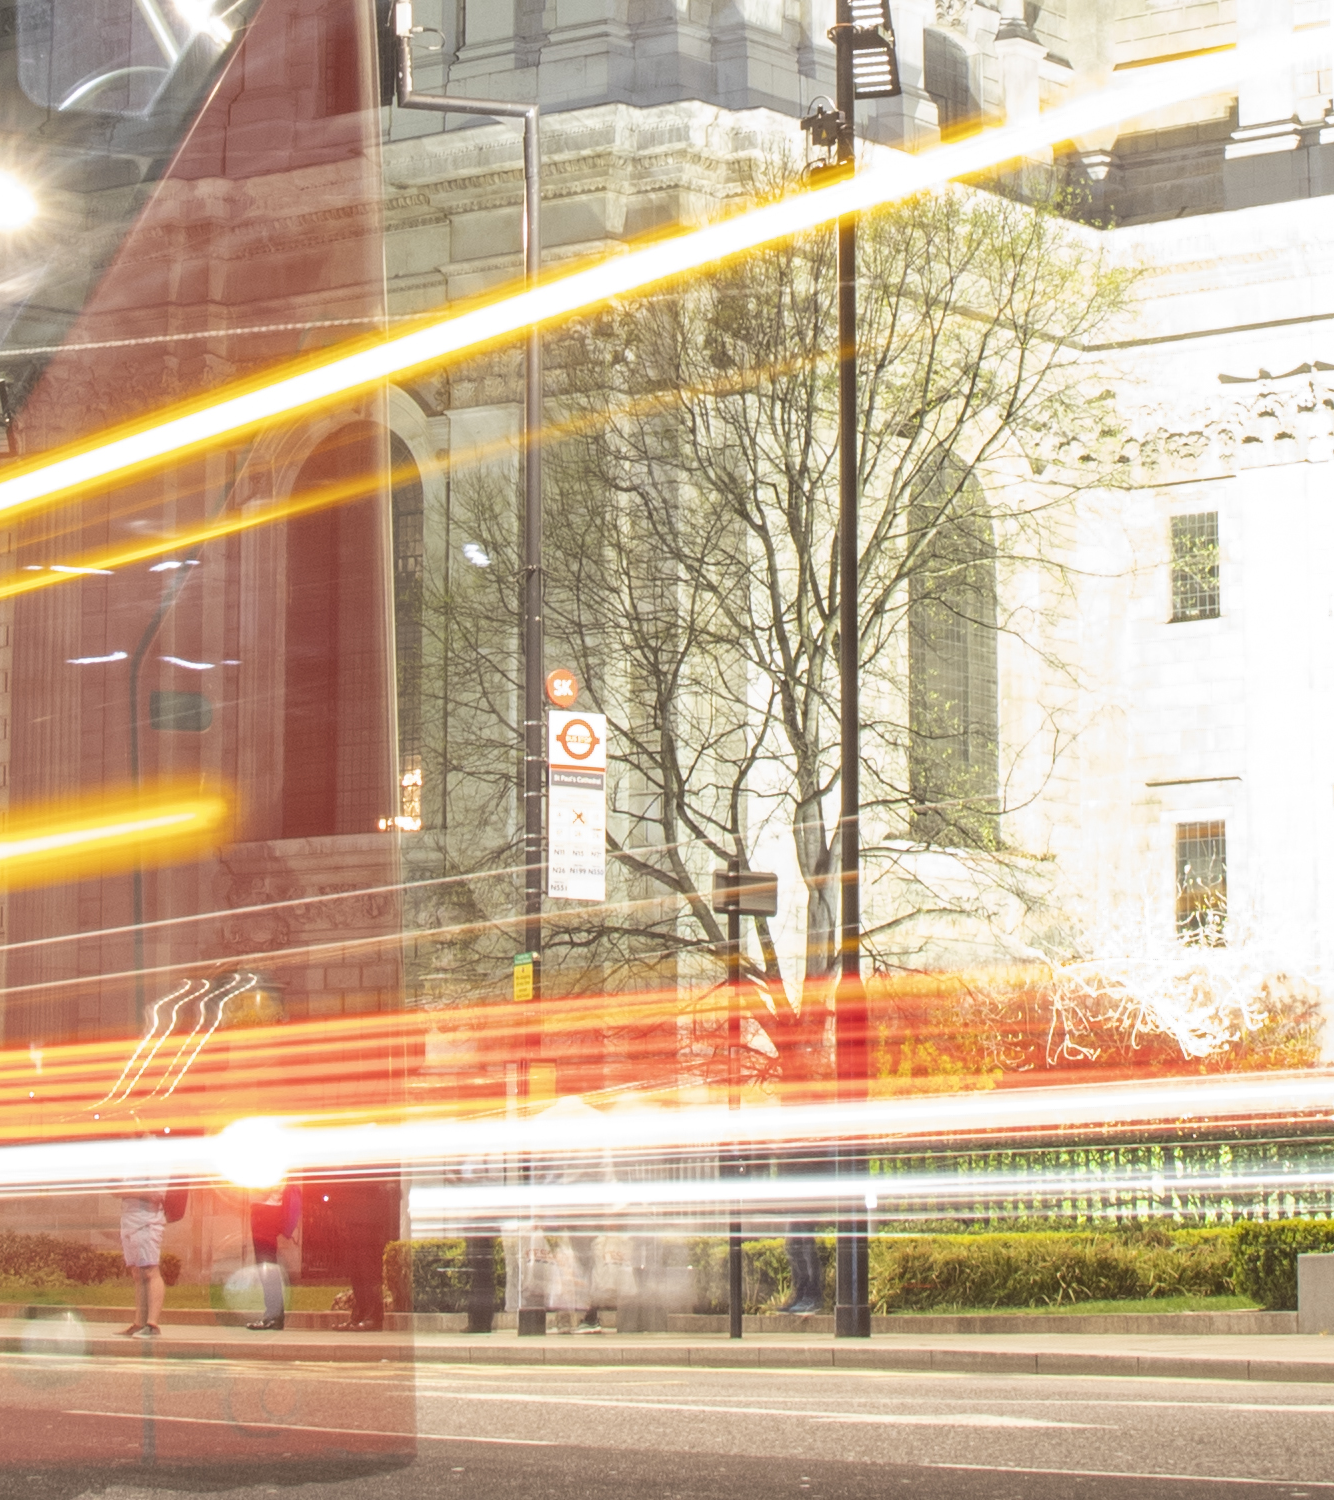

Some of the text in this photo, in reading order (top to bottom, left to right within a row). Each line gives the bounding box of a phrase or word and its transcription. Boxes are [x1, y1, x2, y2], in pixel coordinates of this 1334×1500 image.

[553, 678, 573, 697] SK
[553, 773, 602, 785] St Paul's Cathedral
[572, 849, 584, 857] N15
[552, 866, 566, 874] N26
[569, 867, 587, 875] N199
[550, 884, 568, 892] N551
